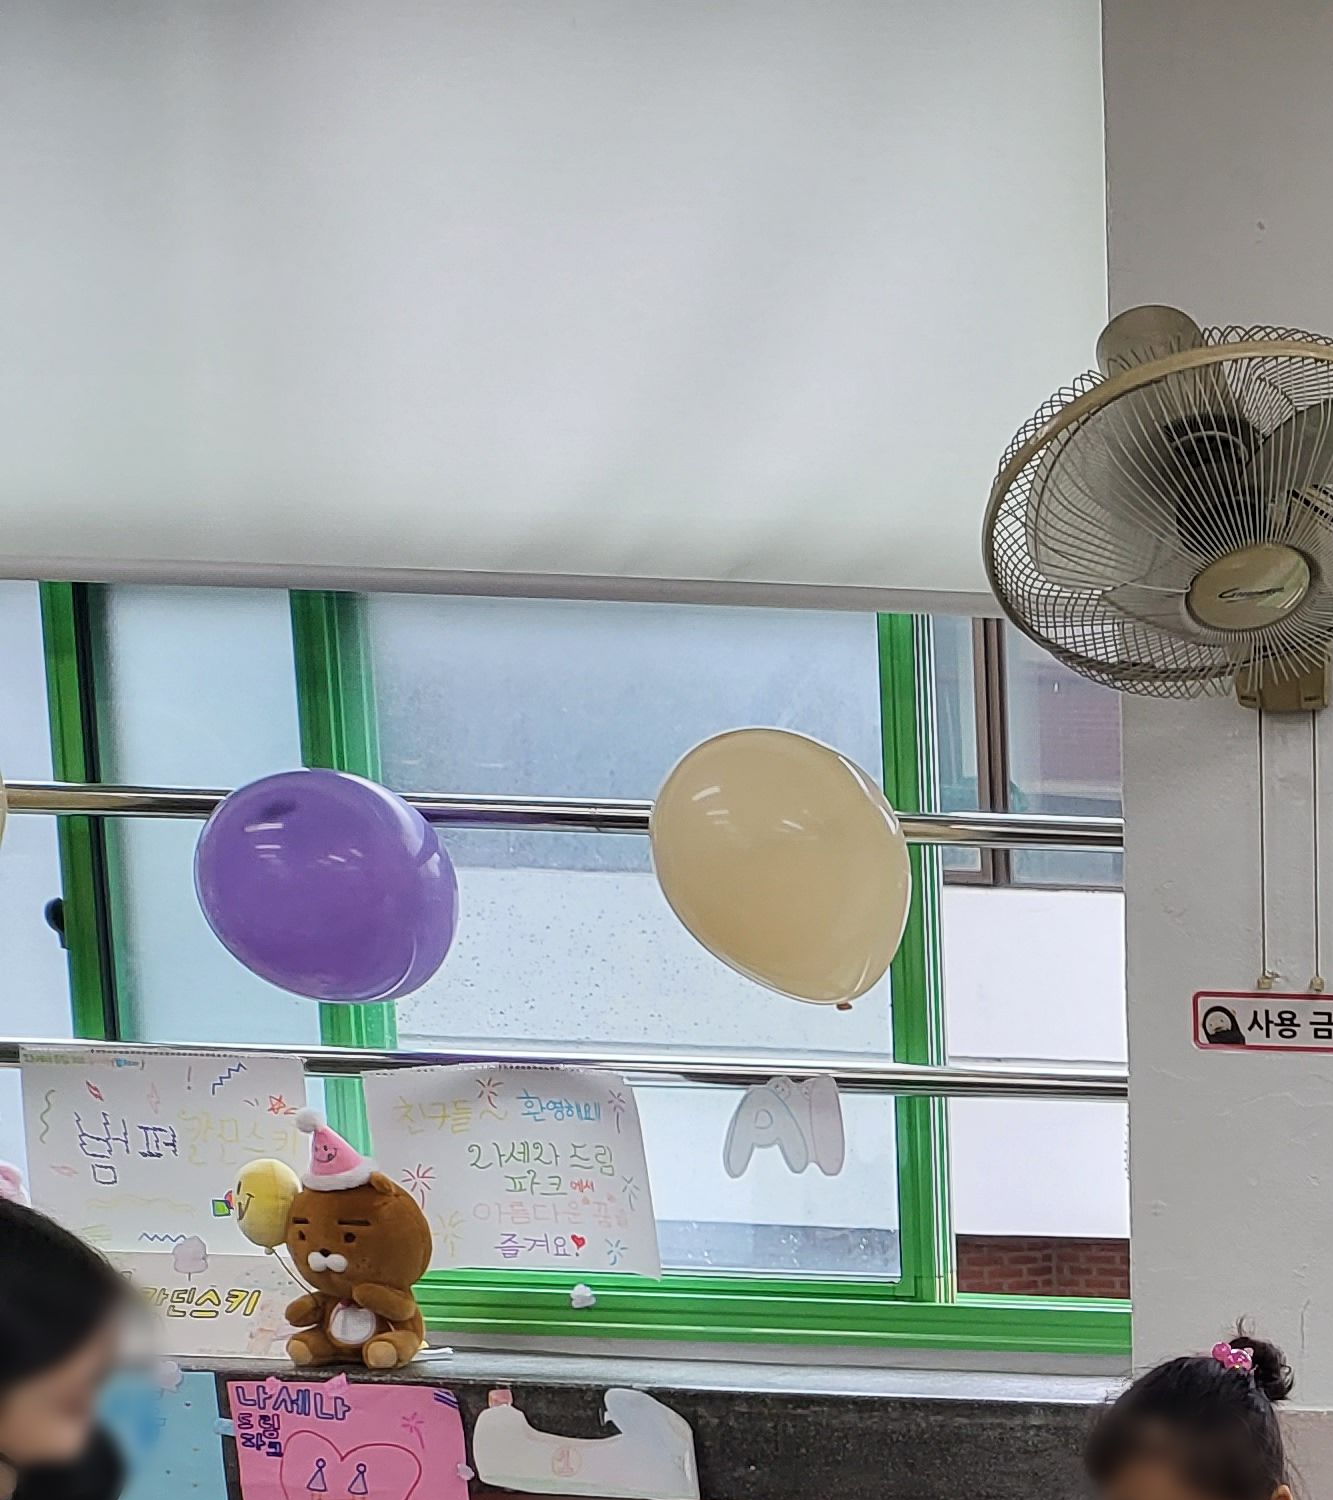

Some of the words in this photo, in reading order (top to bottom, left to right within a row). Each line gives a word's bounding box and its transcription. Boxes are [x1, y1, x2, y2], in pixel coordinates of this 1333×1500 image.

[1247, 1009, 1300, 1040] 사용
[569, 1142, 616, 1177] 드림
[472, 1200, 584, 1226] 아름다운
[235, 1385, 351, 1421] 나세나
